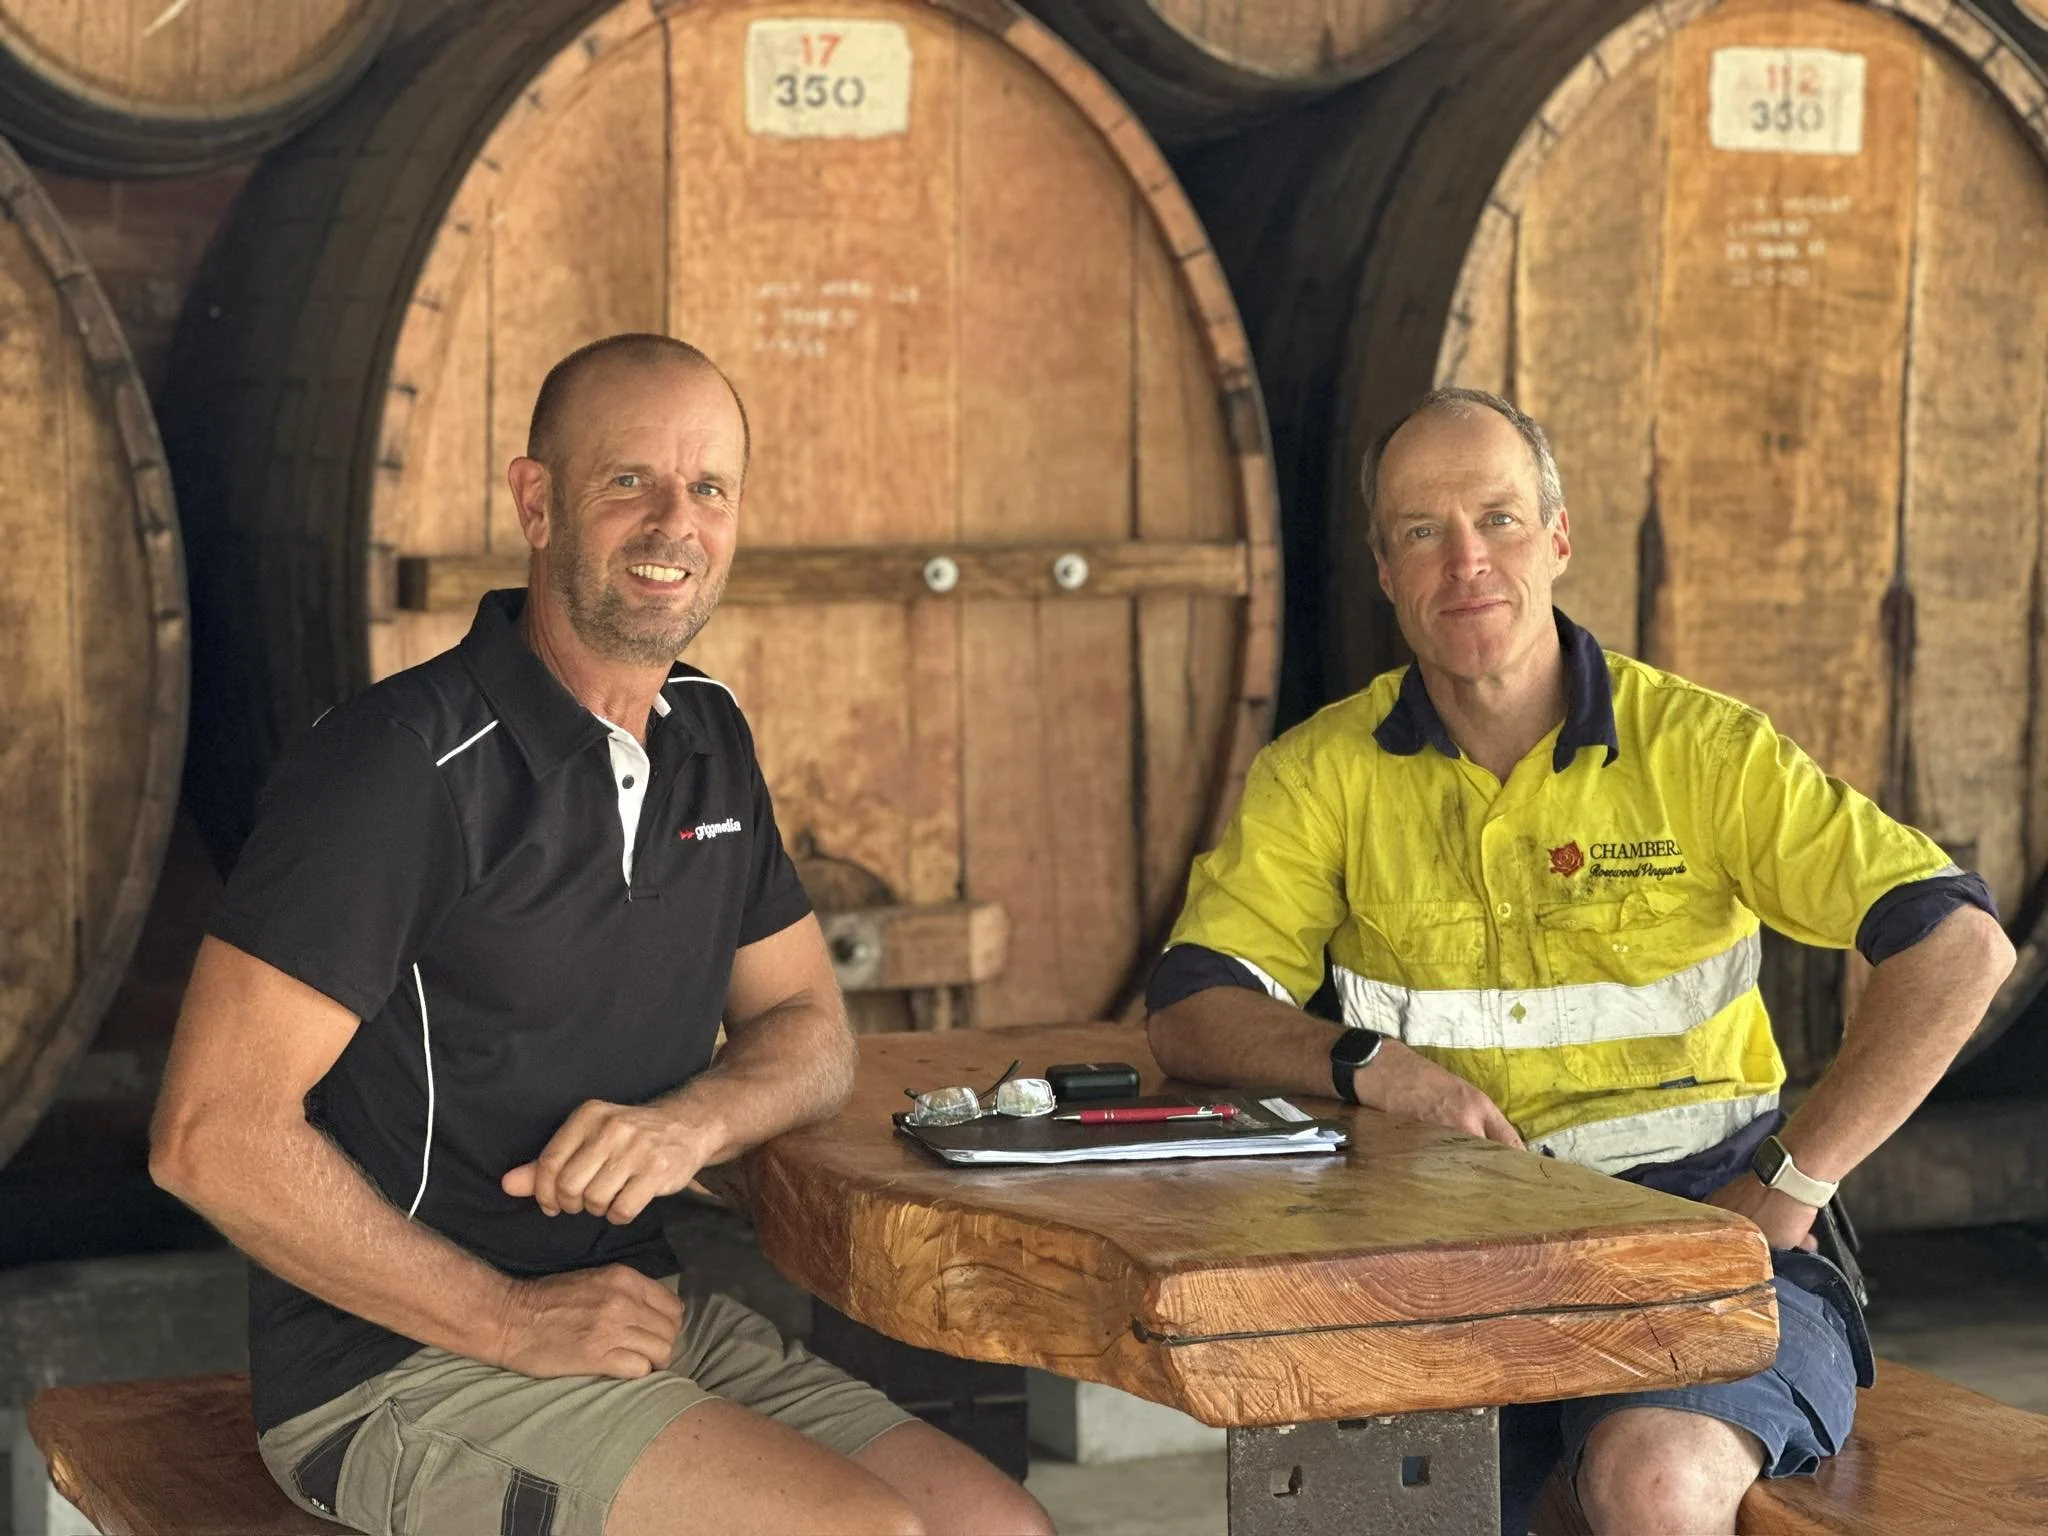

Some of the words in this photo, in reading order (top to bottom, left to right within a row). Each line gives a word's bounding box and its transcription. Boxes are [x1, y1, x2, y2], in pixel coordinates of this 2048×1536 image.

[800, 34, 841, 67] 17
[775, 74, 865, 108] 350
[1767, 64, 1821, 97] 112
[1752, 100, 1824, 133] 350
[1590, 840, 1682, 859] CHAMBER
[1590, 863, 1639, 878] Rosewood
[1640, 861, 1687, 881] Vineyards
